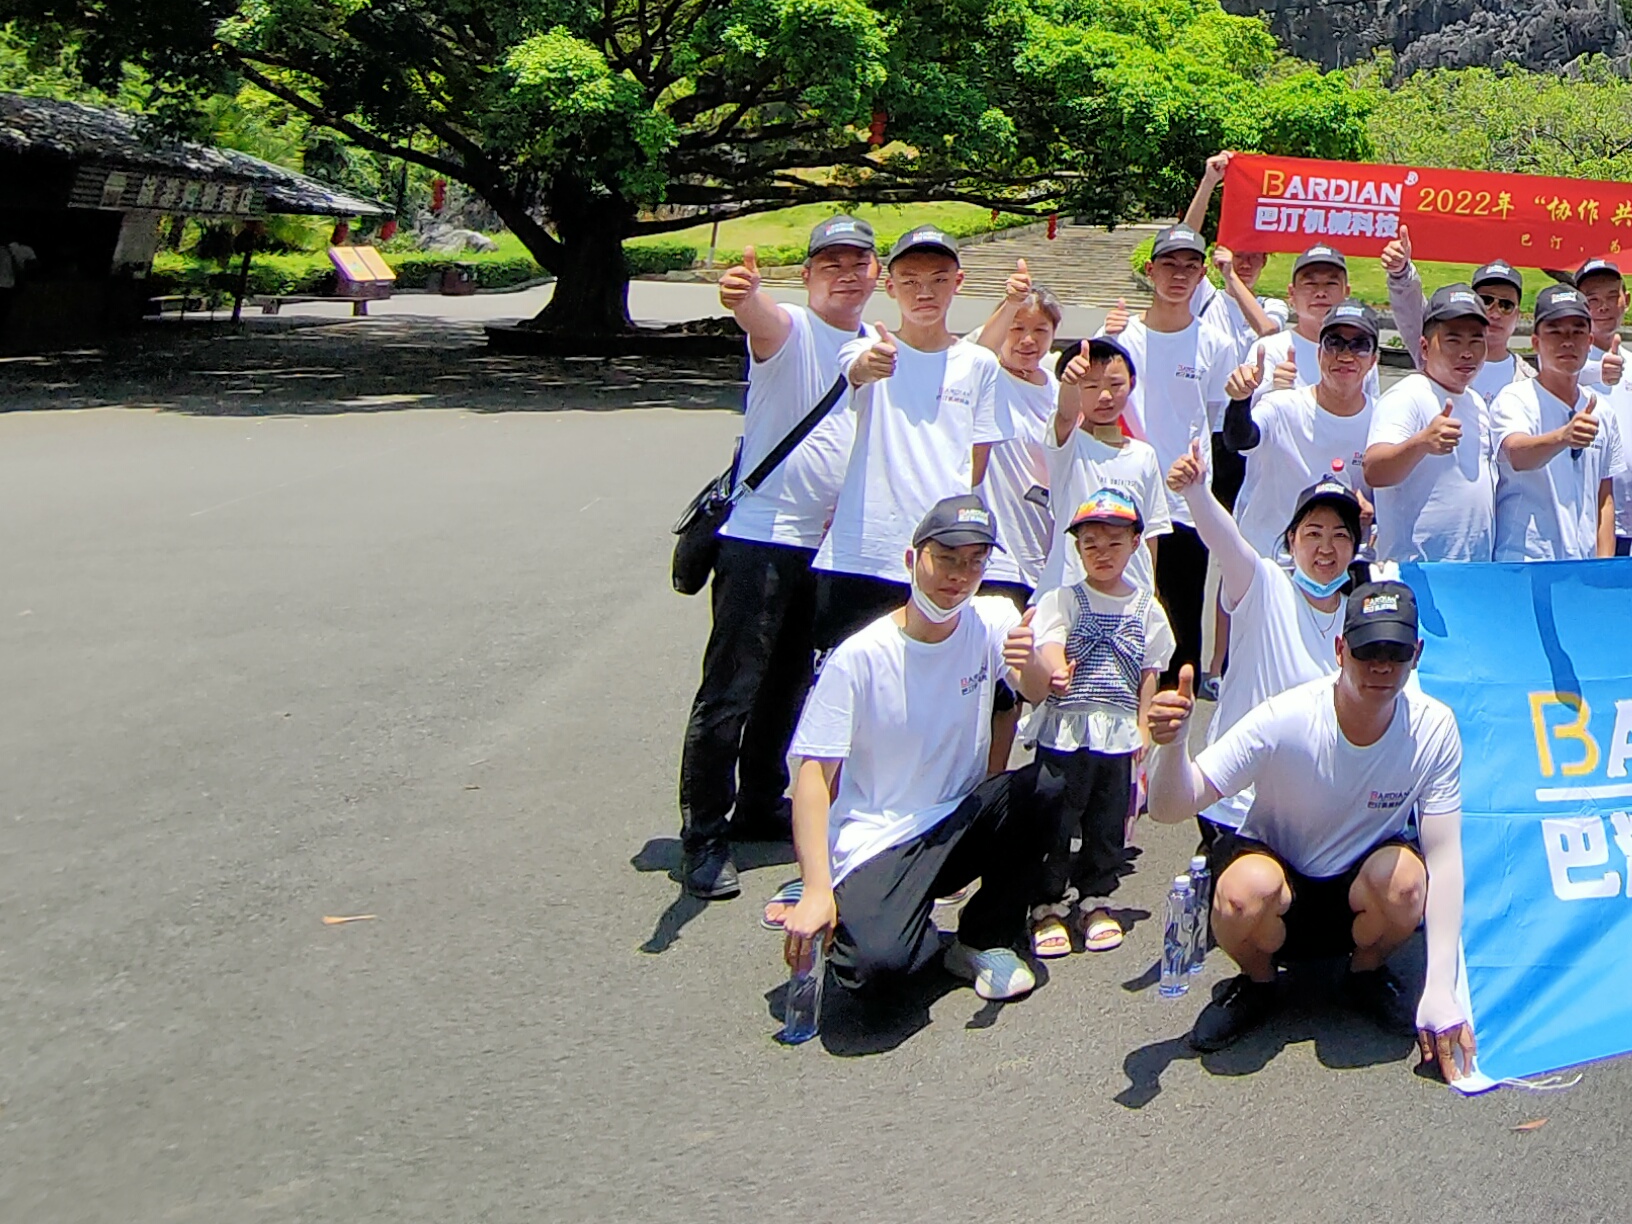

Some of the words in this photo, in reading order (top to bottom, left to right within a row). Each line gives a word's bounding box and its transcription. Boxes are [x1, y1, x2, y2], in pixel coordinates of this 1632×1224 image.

[1262, 169, 1402, 205] BARDIAN
[1255, 206, 1399, 238] 巴汀机械科技
[1370, 790, 1410, 801] BARDIAN
